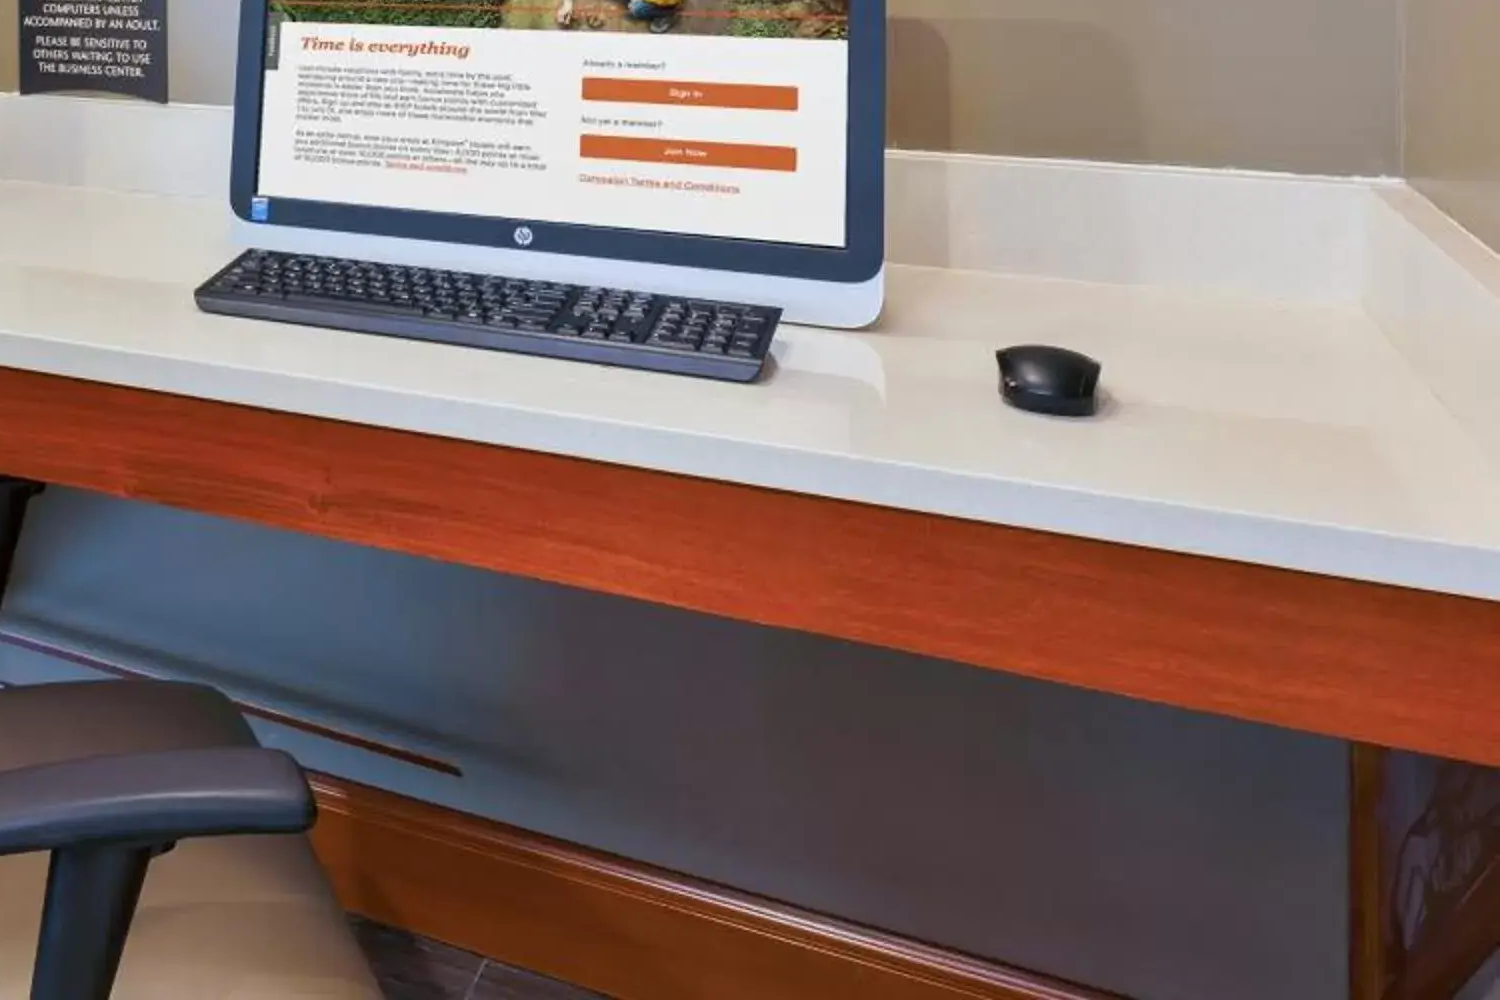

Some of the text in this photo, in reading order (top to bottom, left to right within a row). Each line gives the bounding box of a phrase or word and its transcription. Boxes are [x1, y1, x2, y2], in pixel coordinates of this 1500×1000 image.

[43, 3, 139, 17] COMPUTERS UNLESS
[24, 16, 92, 29] ACCOMPANIED
[94, 17, 106, 29] BY
[108, 18, 123, 29] AN
[35, 36, 147, 50] PLEASE BE SENSITIVE TO
[300, 35, 471, 59] Time is everything
[32, 49, 151, 65] OTHERS WAITING TO USE
[38, 62, 57, 74] THE
[58, 63, 103, 75] BUSINESS
